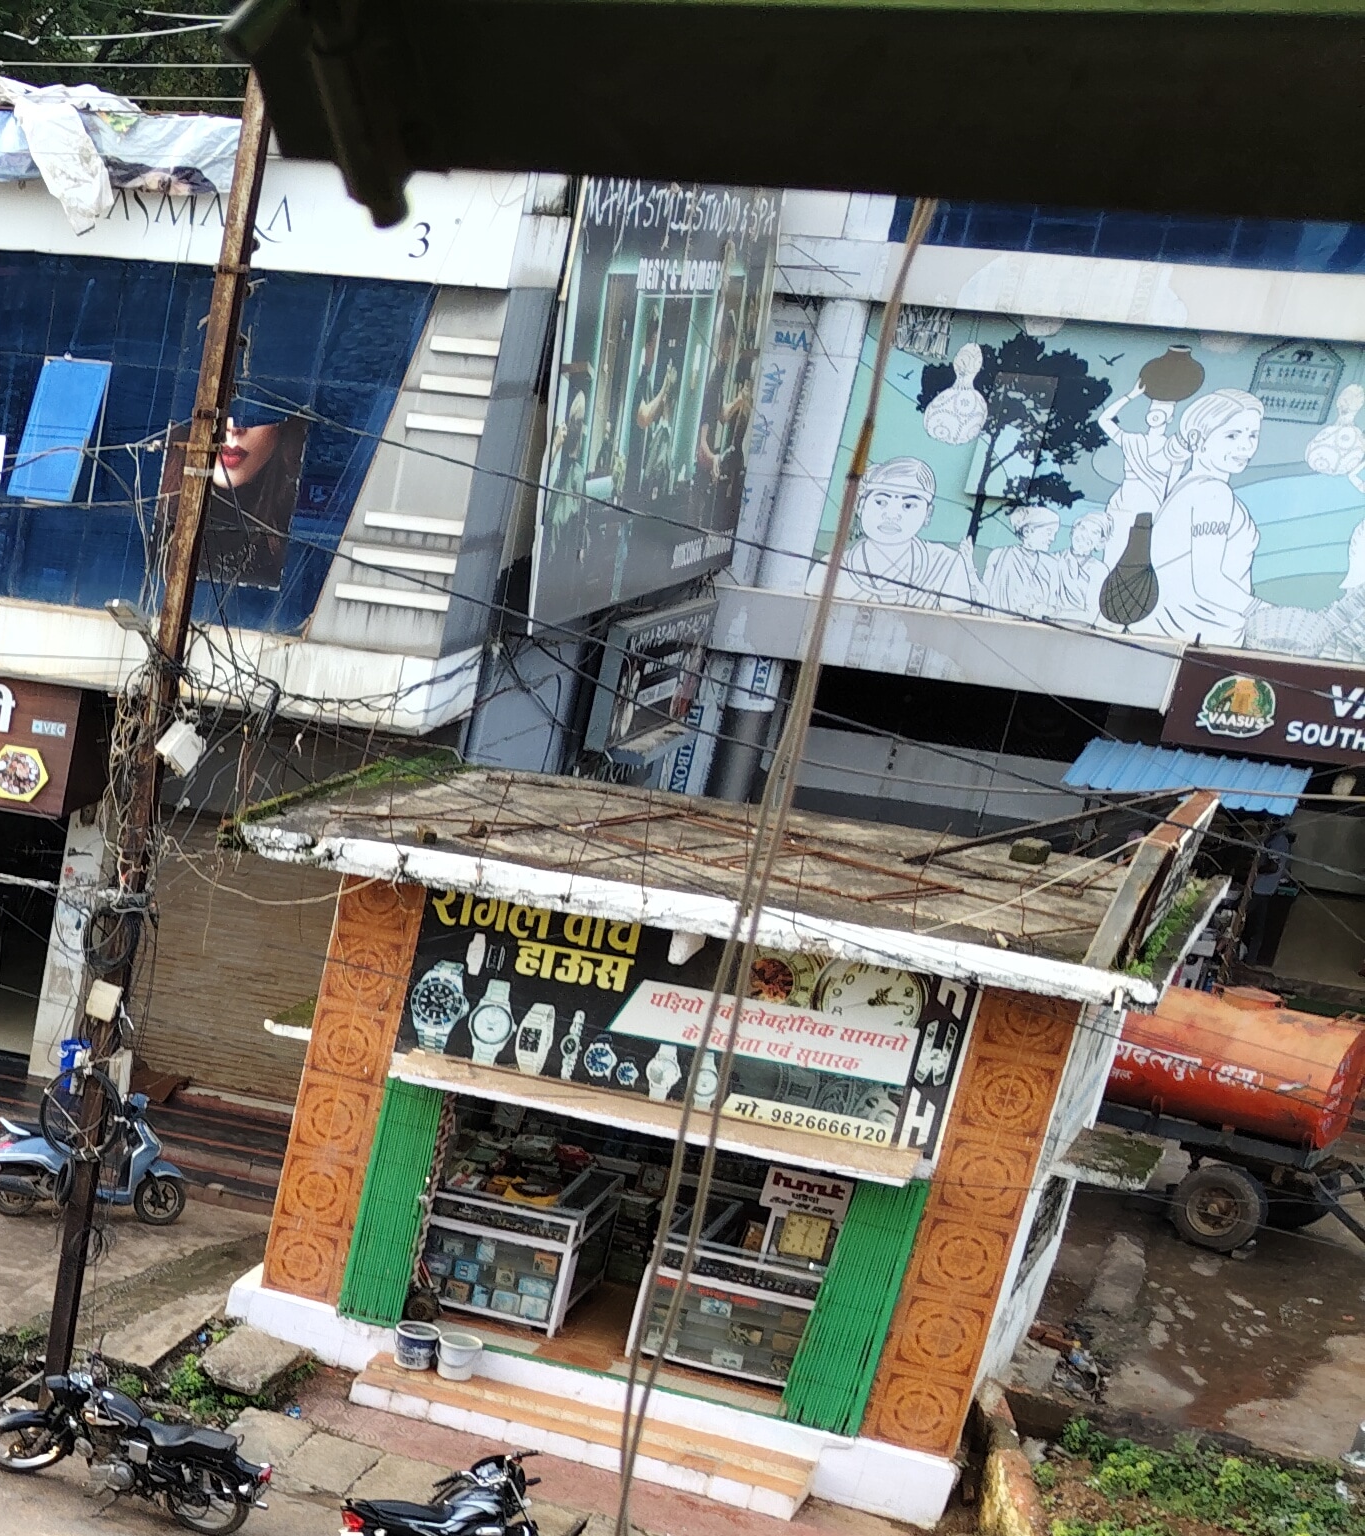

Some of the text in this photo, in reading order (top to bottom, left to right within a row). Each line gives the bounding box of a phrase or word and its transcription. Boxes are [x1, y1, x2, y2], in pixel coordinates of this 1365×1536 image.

[680, 260, 722, 291] WOMEN'
[42, 721, 66, 737] VEG
[1208, 711, 1266, 730] VAASU'S
[766, 1040, 794, 1058] एवं
[796, 1049, 863, 1071] सुधारक
[771, 1109, 887, 1143] 9826666120
